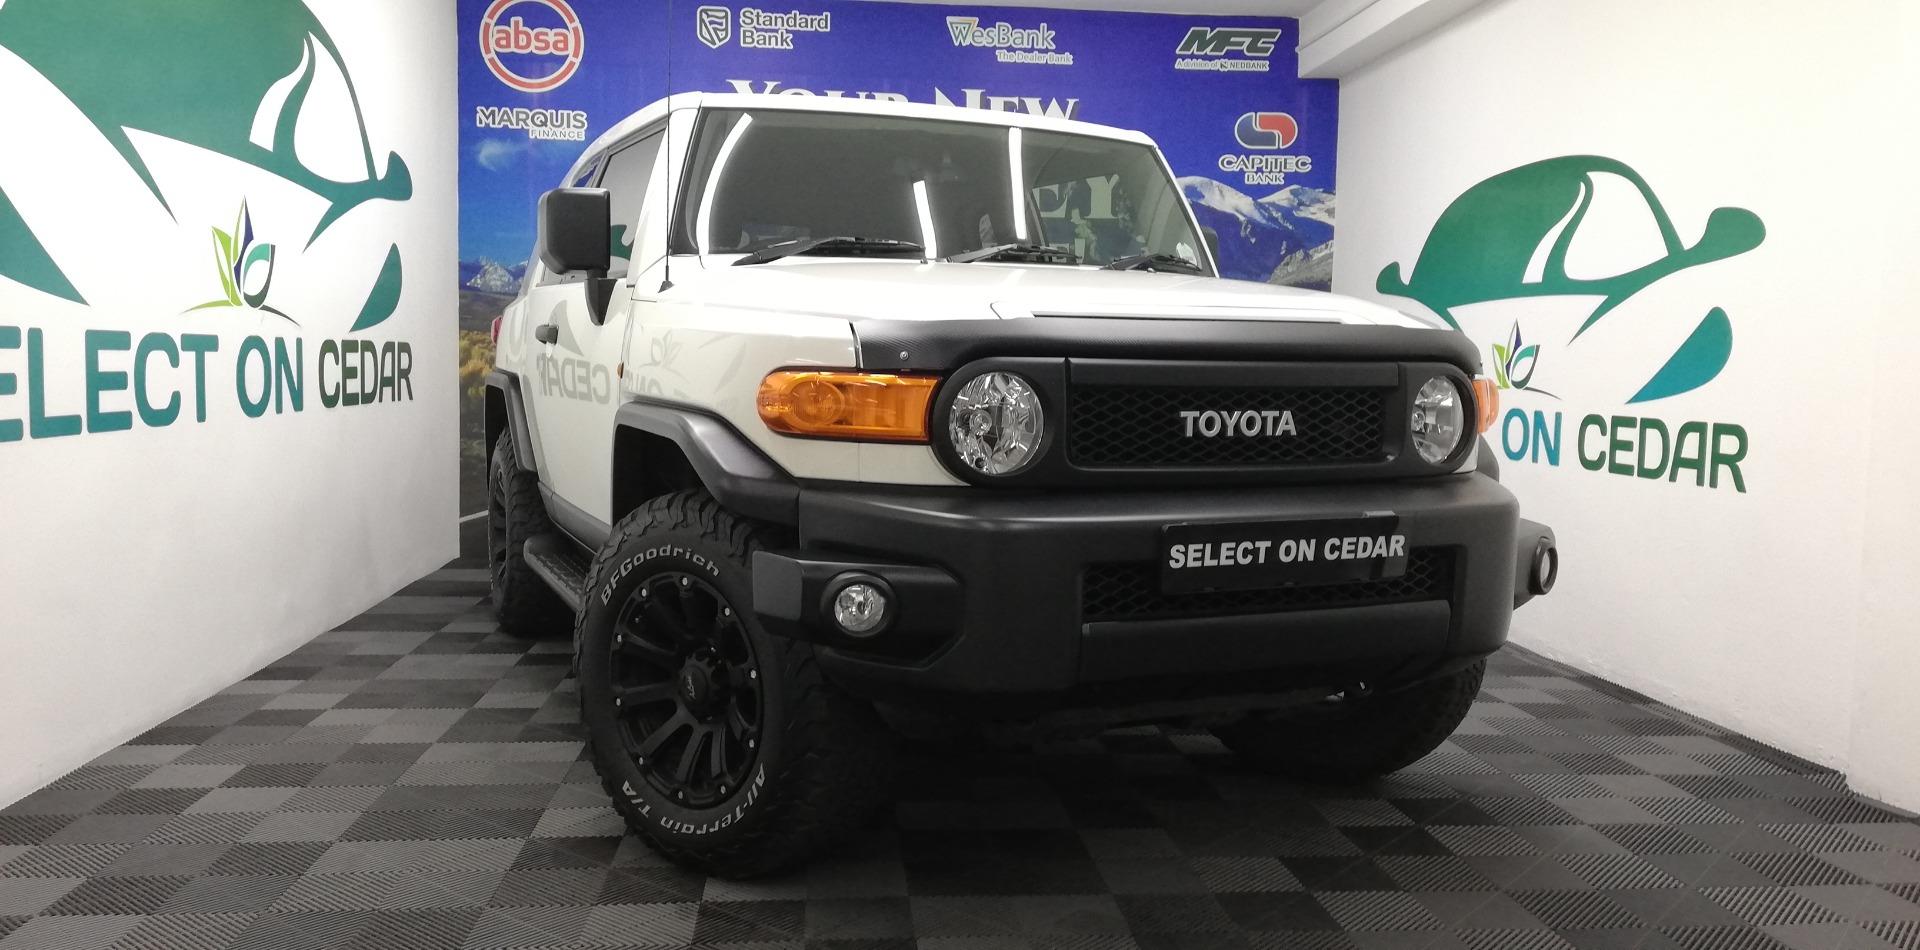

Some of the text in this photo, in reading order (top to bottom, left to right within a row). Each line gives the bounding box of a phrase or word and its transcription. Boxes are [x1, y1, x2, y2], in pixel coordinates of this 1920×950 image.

[741, 9, 829, 31] Standard
[947, 17, 1056, 48] WesBank
[493, 18, 569, 53] absa
[741, 29, 792, 48] Bank
[1177, 28, 1281, 55] MFC
[997, 50, 1072, 64] The Dealer Bank
[1183, 60, 1209, 69] division
[1210, 60, 1218, 69] of
[1229, 61, 1268, 70] NEDBANK
[478, 108, 586, 129] MARQUIS
[531, 129, 584, 139] FINANCE
[1219, 155, 1311, 171] CAPITEC
[1245, 173, 1284, 184] BANK
[236, 335, 303, 418] ON
[318, 339, 413, 409] CEDAR
[1180, 410, 1296, 437] TOYOTA
[1502, 408, 1749, 494] ON CEDAR
[1169, 534, 1405, 569] SELECT ON CEDAR
[601, 544, 720, 606] BFGoodrich
[622, 763, 766, 835] All-Terrain T/A
